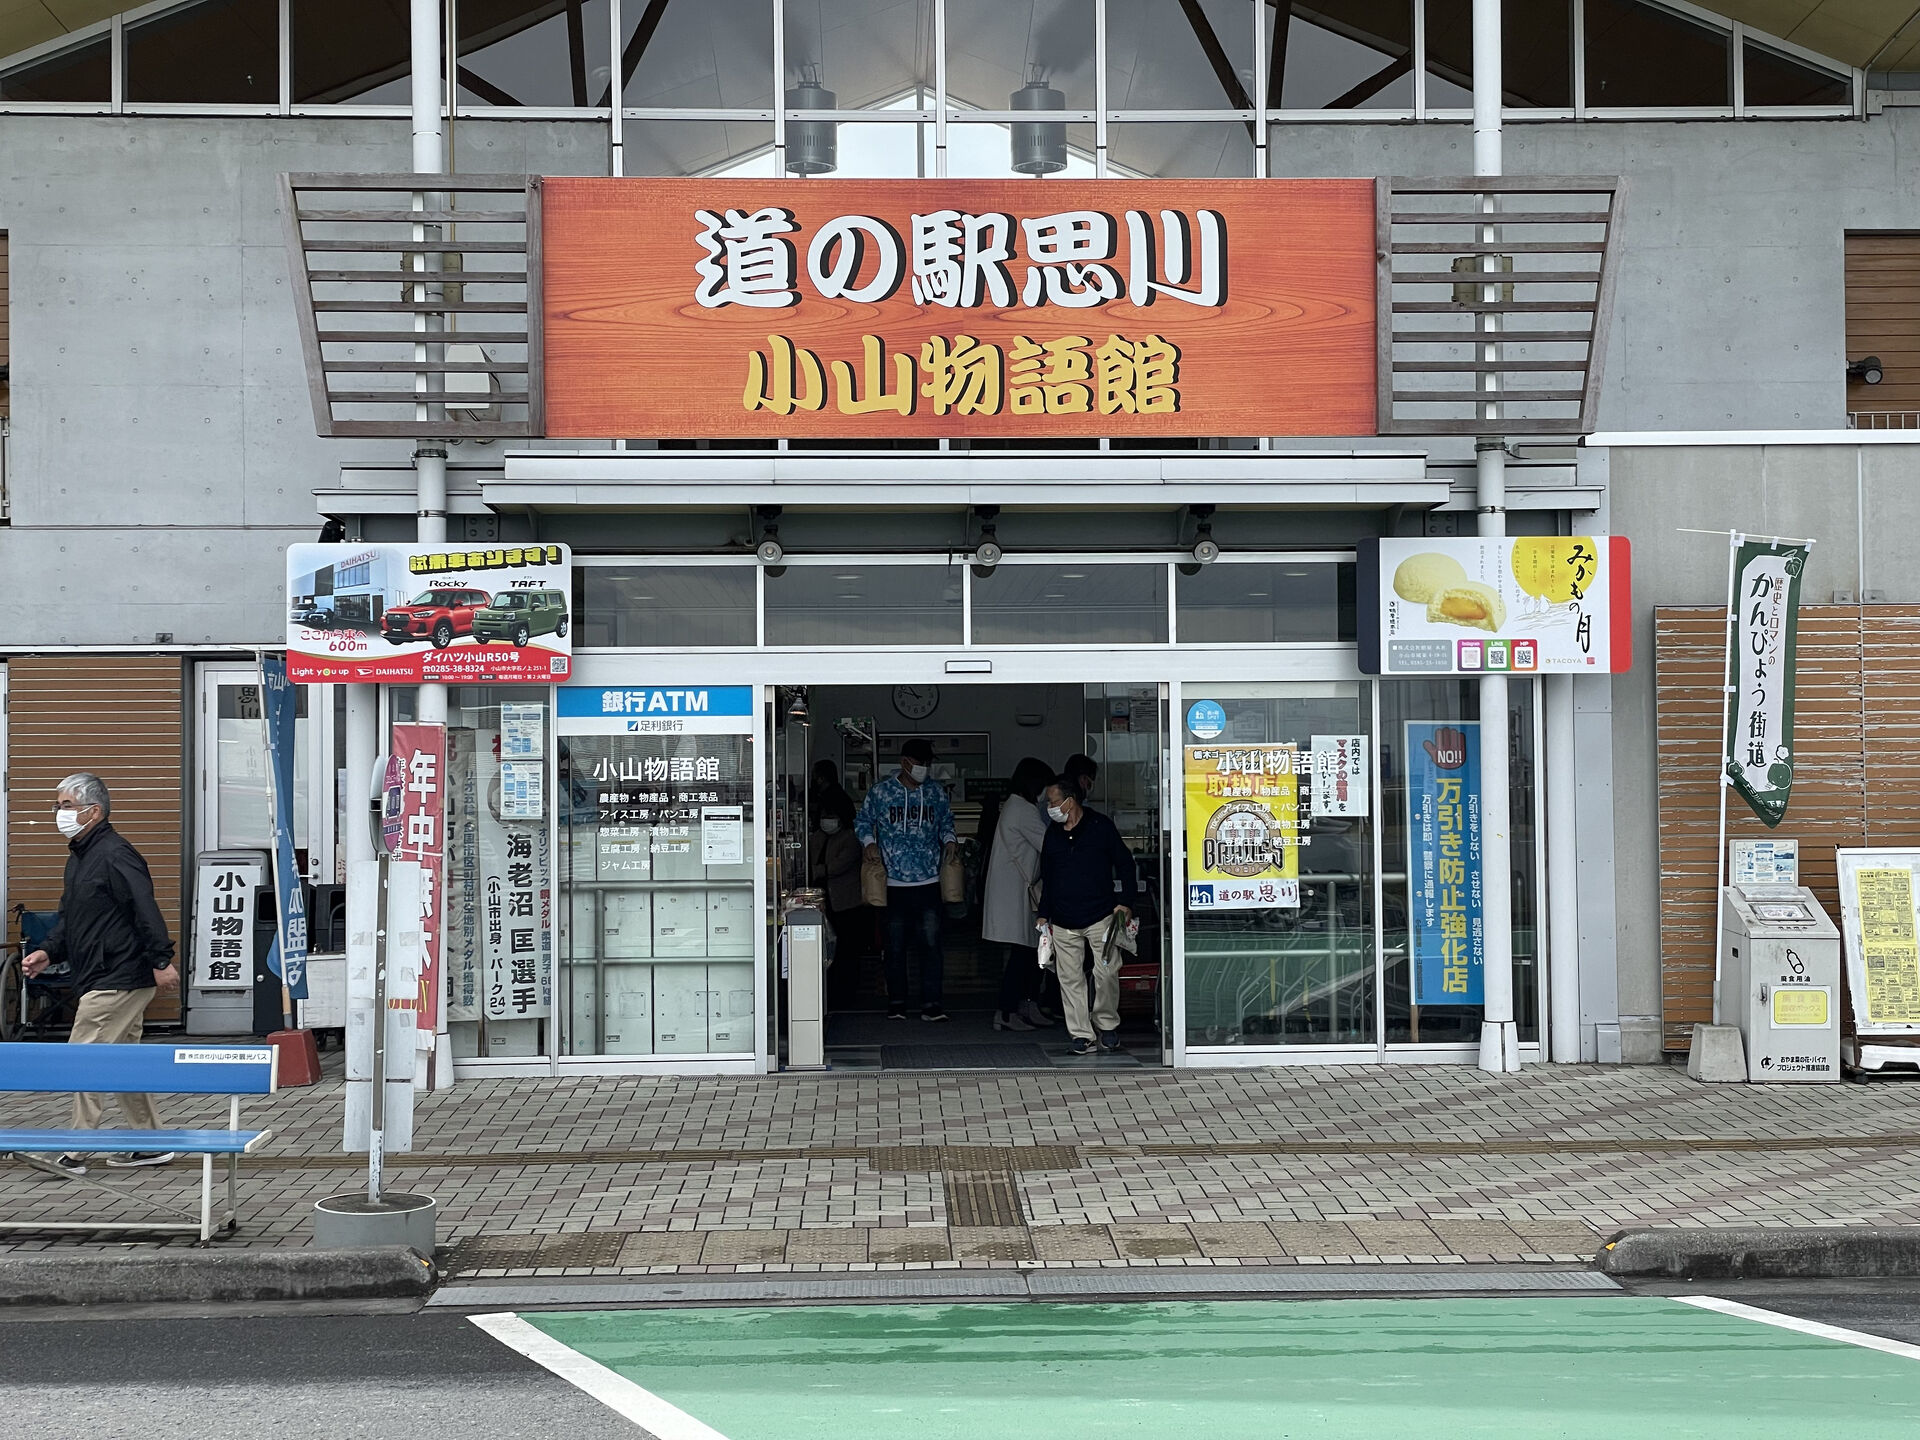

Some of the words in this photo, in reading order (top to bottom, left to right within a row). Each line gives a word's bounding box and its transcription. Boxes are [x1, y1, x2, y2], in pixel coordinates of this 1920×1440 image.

[694, 207, 1228, 307] 道の駅思川
[742, 334, 1181, 416] 小山物語館
[341, 550, 377, 569] DAIHATSU
[429, 580, 468, 588] Rocky
[510, 580, 547, 588] TAFT
[1567, 545, 1594, 654] みかもの月
[1768, 577, 1785, 666] 歴史とロマンの
[300, 629, 367, 641] ここから東へ
[328, 641, 368, 652] 600m
[422, 651, 520, 663] ダイハツ小山R50号
[291, 668, 314, 677] Light
[316, 669, 336, 677] you
[430, 665, 485, 673] 0285-38-8324
[1747, 572, 1774, 768] かんぴょう街道
[602, 691, 709, 713] 銀行ATM
[640, 720, 683, 731] 足利銀行
[1216, 750, 1340, 775] 小山物語館
[1352, 738, 1361, 776] 店内では
[1437, 750, 1463, 764] NO!!
[593, 756, 720, 781] 小山物語館
[599, 792, 719, 804] 農産物・物産品・商工芸品
[599, 808, 699, 820] アイス工房・パン工房
[1468, 794, 1480, 860] 万引きをしない
[600, 843, 690, 854] 豆腐工房・納豆工房
[601, 860, 651, 870] ジャム工房
[1218, 889, 1255, 901] 道の駅
[1258, 884, 1298, 904] 思川
[1436, 777, 1468, 993] 万引き防止強化店
[1471, 870, 1481, 908] させない
[208, 872, 247, 981] 小山物語館
